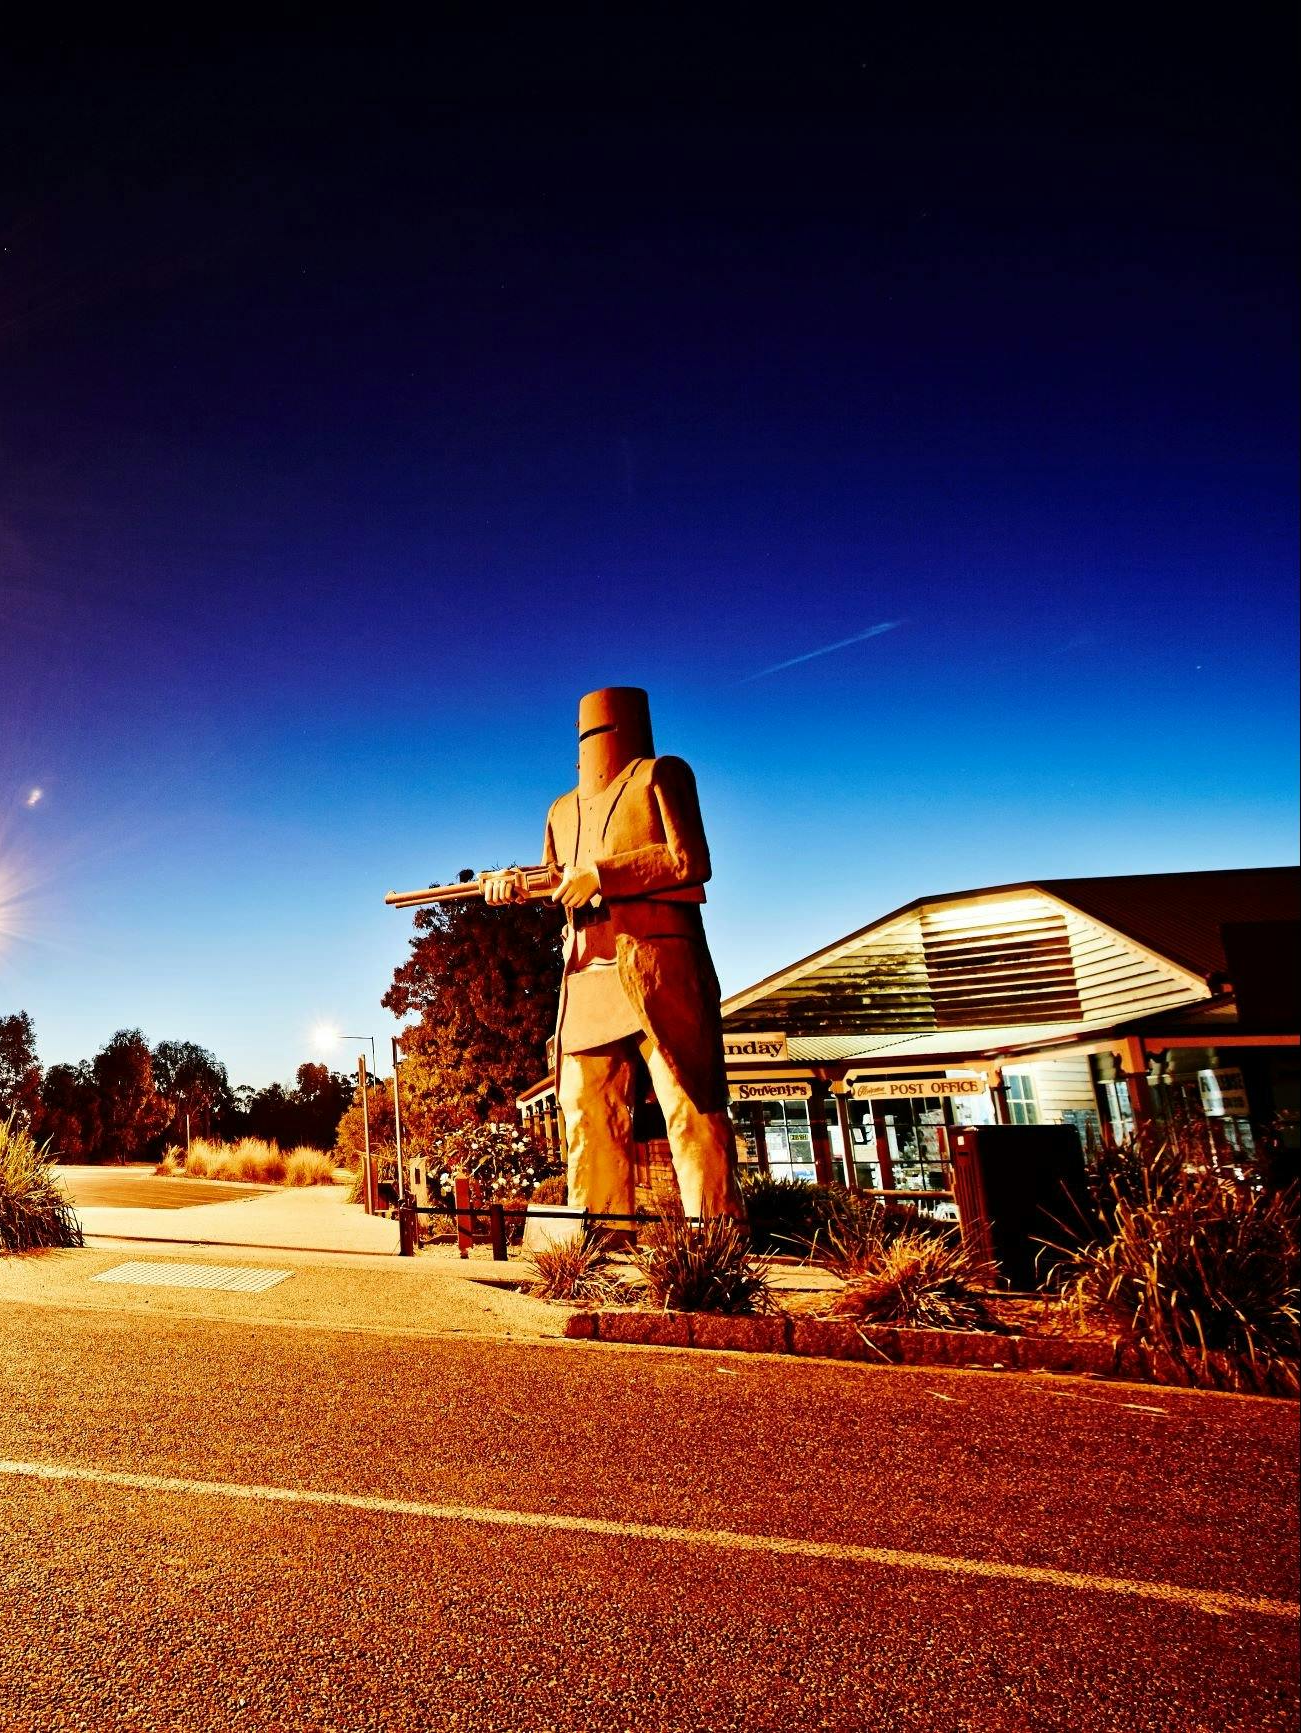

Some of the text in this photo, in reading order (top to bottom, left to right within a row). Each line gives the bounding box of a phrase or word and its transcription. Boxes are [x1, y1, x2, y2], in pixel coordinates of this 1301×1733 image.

[725, 1040, 783, 1058] nday
[890, 1083, 924, 1095] POST
[930, 1081, 978, 1094] OFFICE
